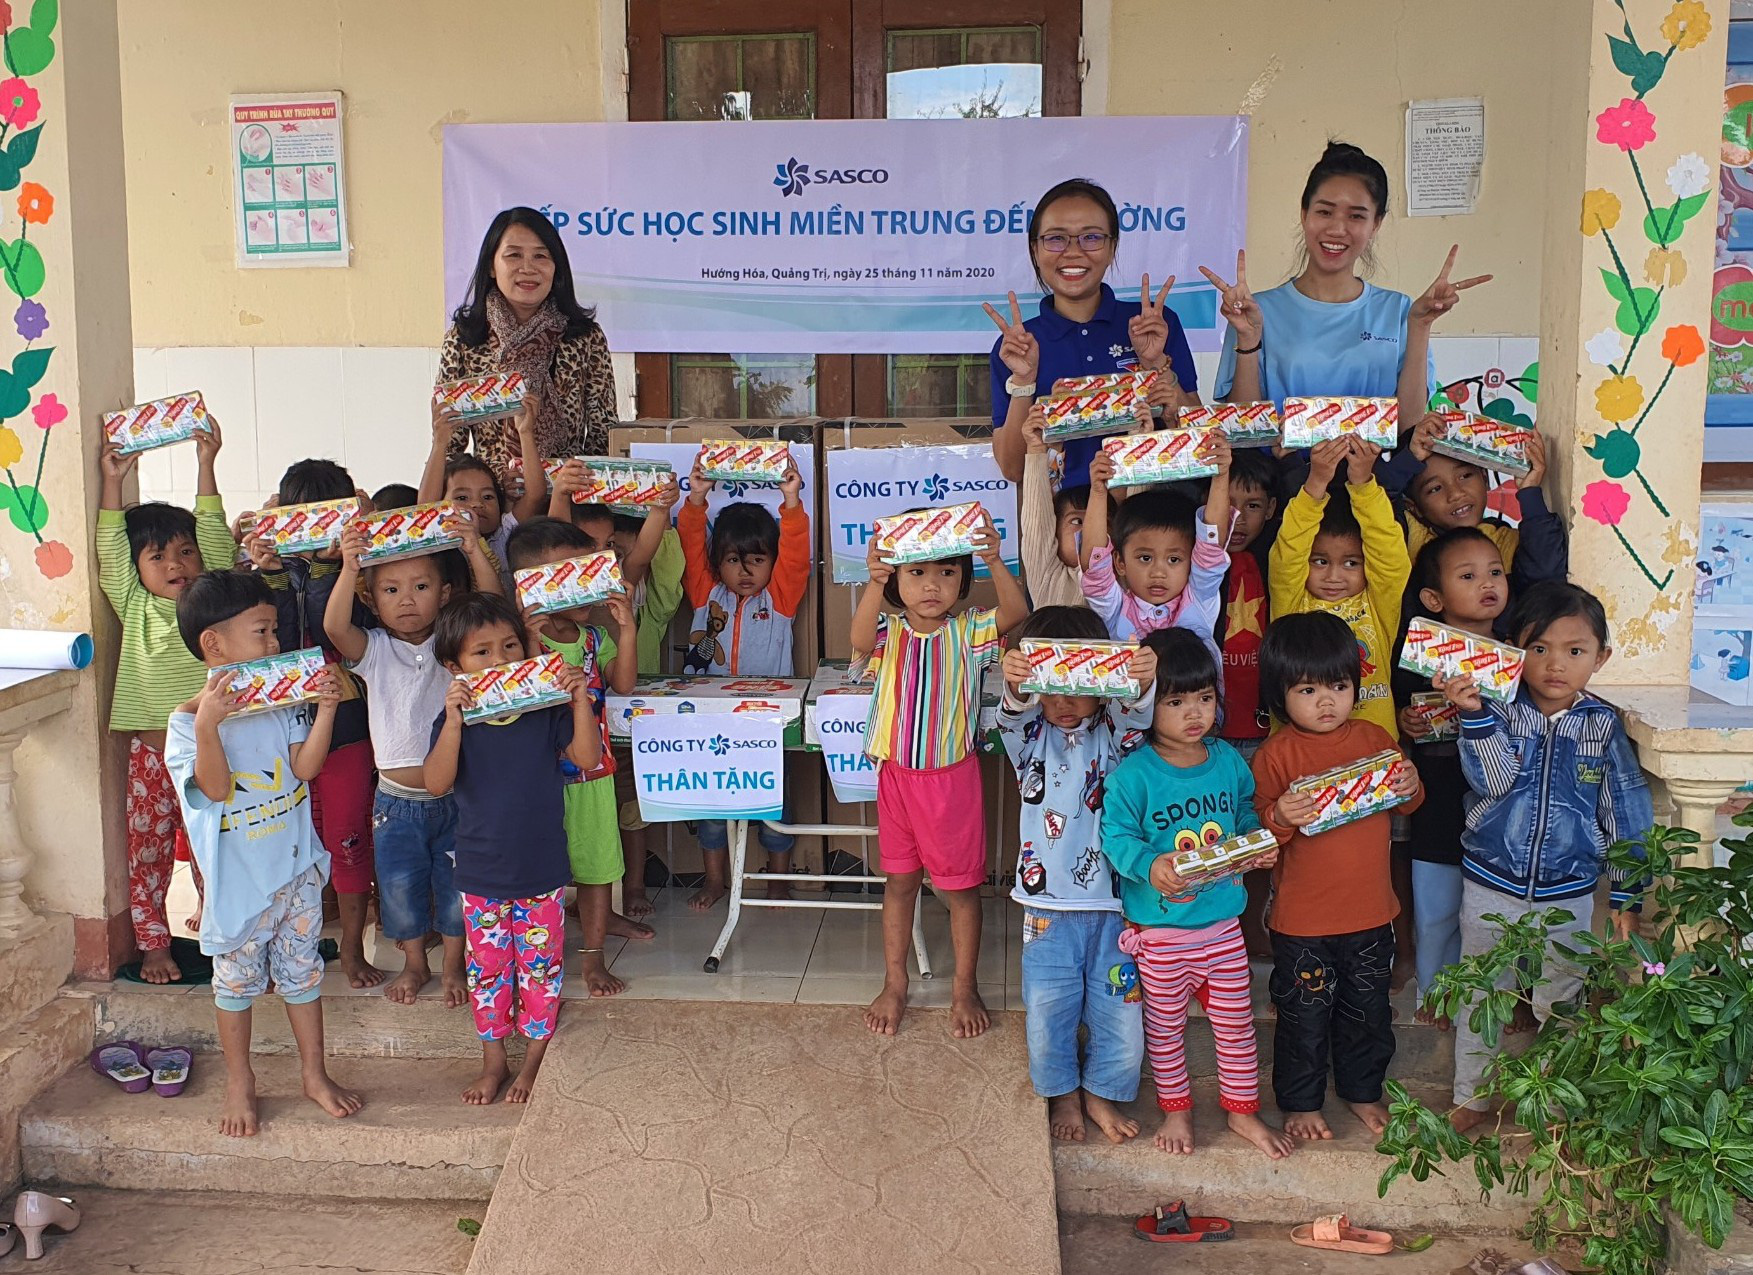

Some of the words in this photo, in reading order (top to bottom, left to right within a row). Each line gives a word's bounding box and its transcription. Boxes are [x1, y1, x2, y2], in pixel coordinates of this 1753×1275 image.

[1425, 126, 1453, 134] THÔNG
[814, 169, 889, 184] SASCO
[578, 207, 634, 236] SỨC
[643, 211, 704, 243] HỌC
[713, 211, 781, 236] SINH
[790, 203, 864, 236] MIỀN
[871, 210, 976, 236] TRUNG
[701, 267, 740, 281] Hướng
[743, 267, 769, 281] Hóa,
[772, 267, 810, 281] Quảng
[812, 267, 831, 281] Trị,
[834, 268, 862, 280] ngày
[864, 268, 879, 278] 25
[882, 267, 917, 281] tháng
[920, 268, 933, 278] 11
[937, 267, 962, 278] năm
[966, 267, 995, 278] 2020
[836, 480, 890, 499] CÔNG
[896, 480, 919, 496] TY
[952, 480, 1008, 491] SASCO
[841, 523, 874, 546] TH
[1240, 650, 1258, 667] VIỆ
[638, 738, 683, 754] CÔNG
[686, 738, 706, 752] TY
[732, 739, 778, 749] SASCO
[643, 768, 708, 792] THÂN
[712, 767, 775, 795] TẶNG
